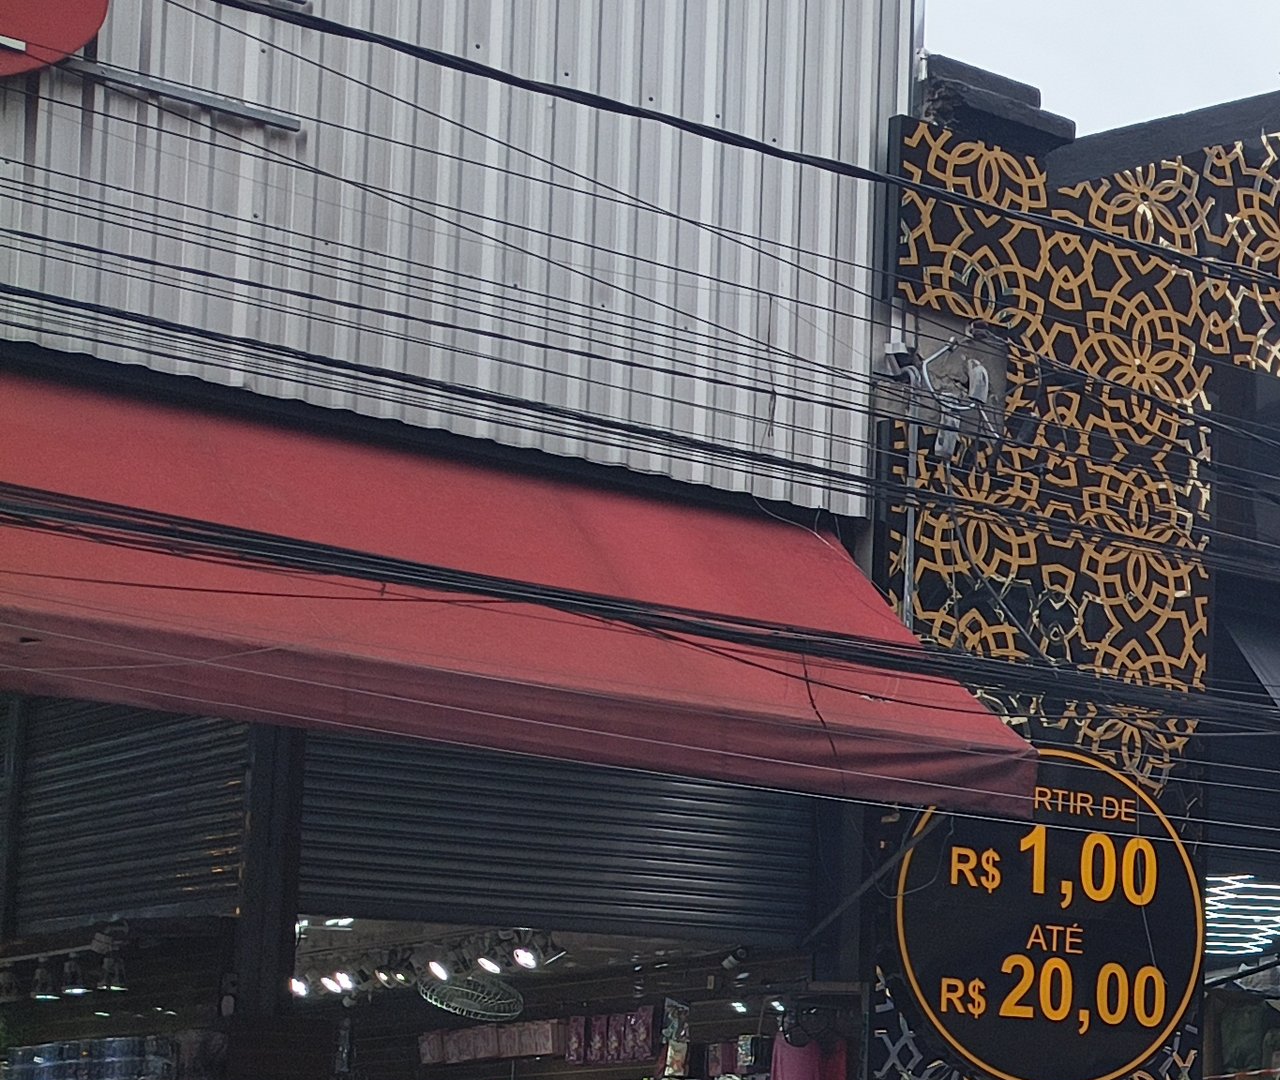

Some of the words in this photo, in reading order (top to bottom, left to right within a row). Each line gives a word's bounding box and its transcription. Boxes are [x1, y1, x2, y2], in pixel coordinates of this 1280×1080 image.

[1034, 786, 1095, 817] RTIR
[1102, 796, 1137, 823] DE
[950, 846, 1002, 895] R$
[1019, 823, 1158, 909] 1,00
[1026, 922, 1084, 955] ATÉ
[939, 976, 987, 1020] R$
[998, 953, 1167, 1036] 20,00
